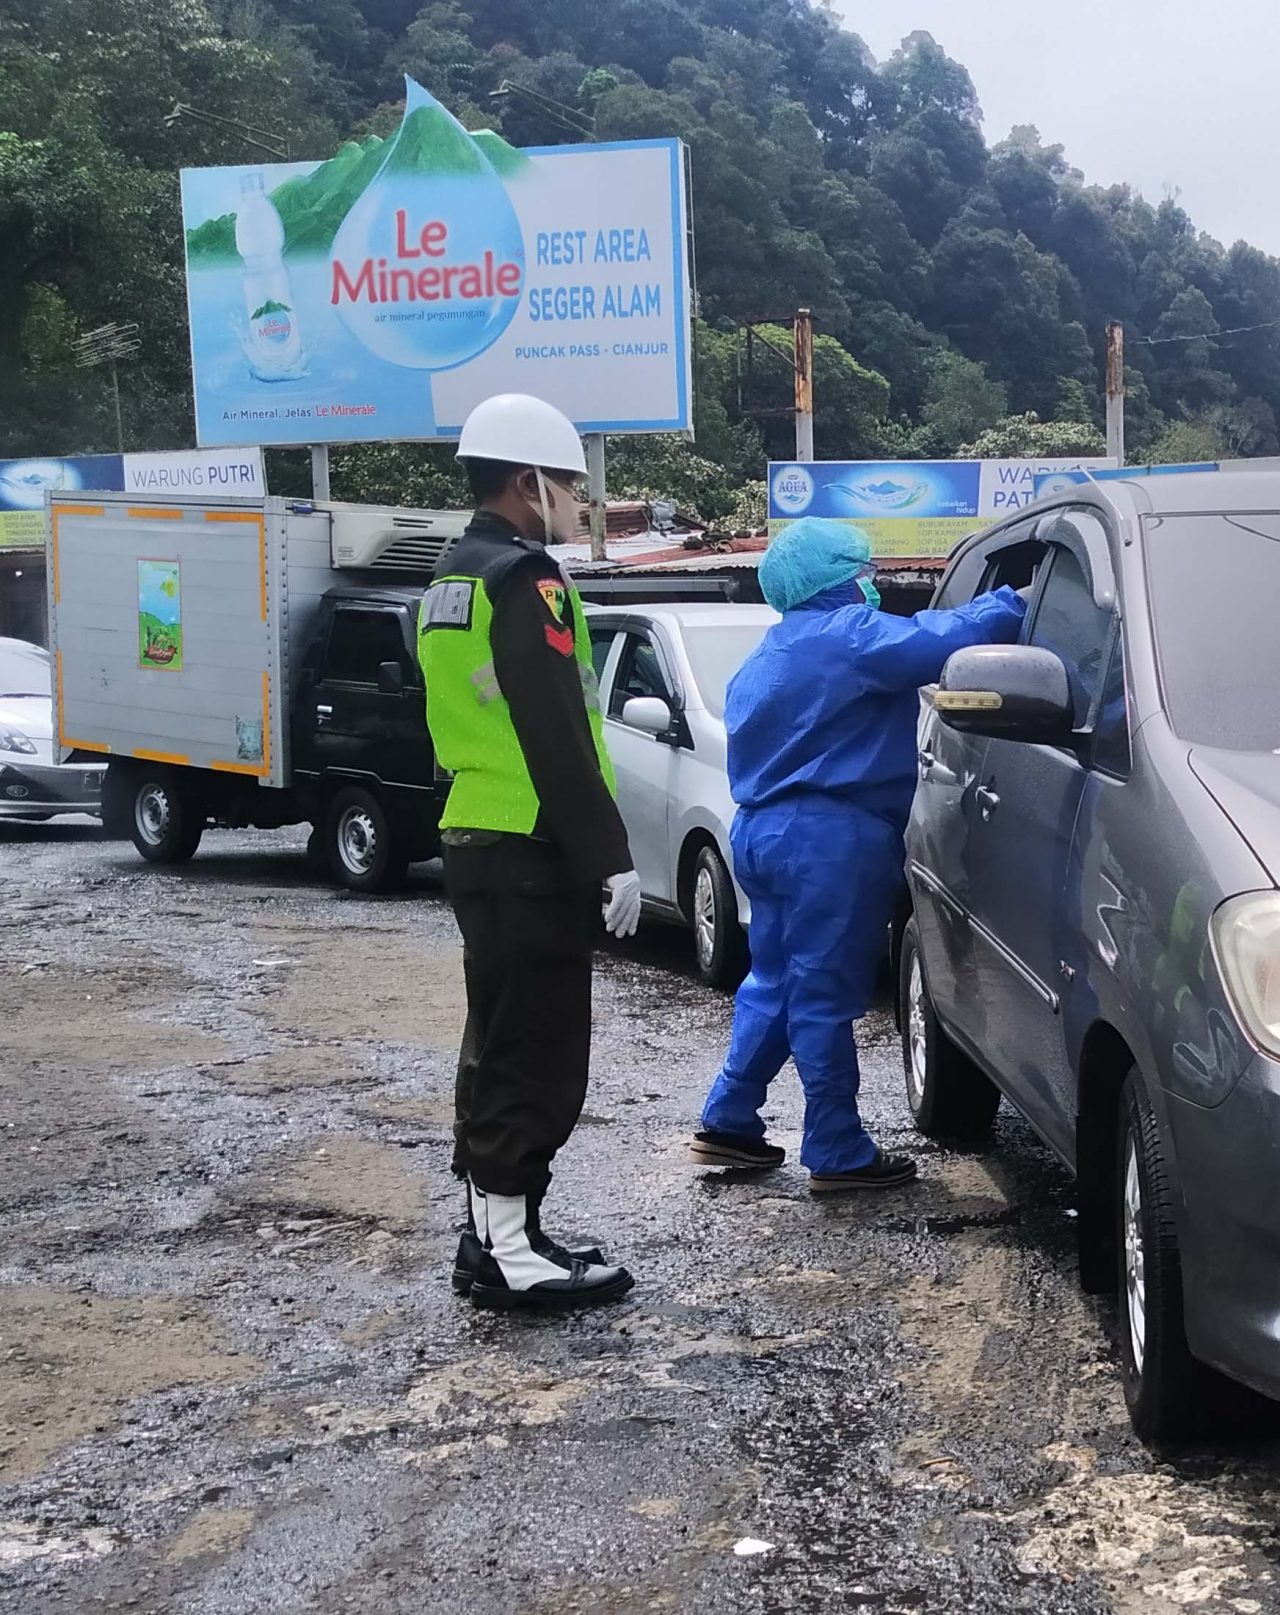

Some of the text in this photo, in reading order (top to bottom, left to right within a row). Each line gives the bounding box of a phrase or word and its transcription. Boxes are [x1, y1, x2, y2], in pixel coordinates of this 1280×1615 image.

[395, 209, 448, 259] Le
[536, 227, 652, 266] REST AREA
[330, 249, 522, 306] Minerale
[529, 284, 661, 322] SEGER ALAM
[374, 313, 388, 323] air
[389, 311, 425, 322] mineral
[515, 346, 566, 359] PUNCAK
[569, 344, 600, 357] PASS
[612, 342, 669, 356] CIANJUR
[222, 411, 238, 420] Air
[284, 408, 312, 418] Jelas
[315, 405, 329, 417] Le
[331, 404, 377, 416] Minerale
[132, 464, 256, 487] WARUNG PUTRI
[778, 480, 808, 493] AQUA
